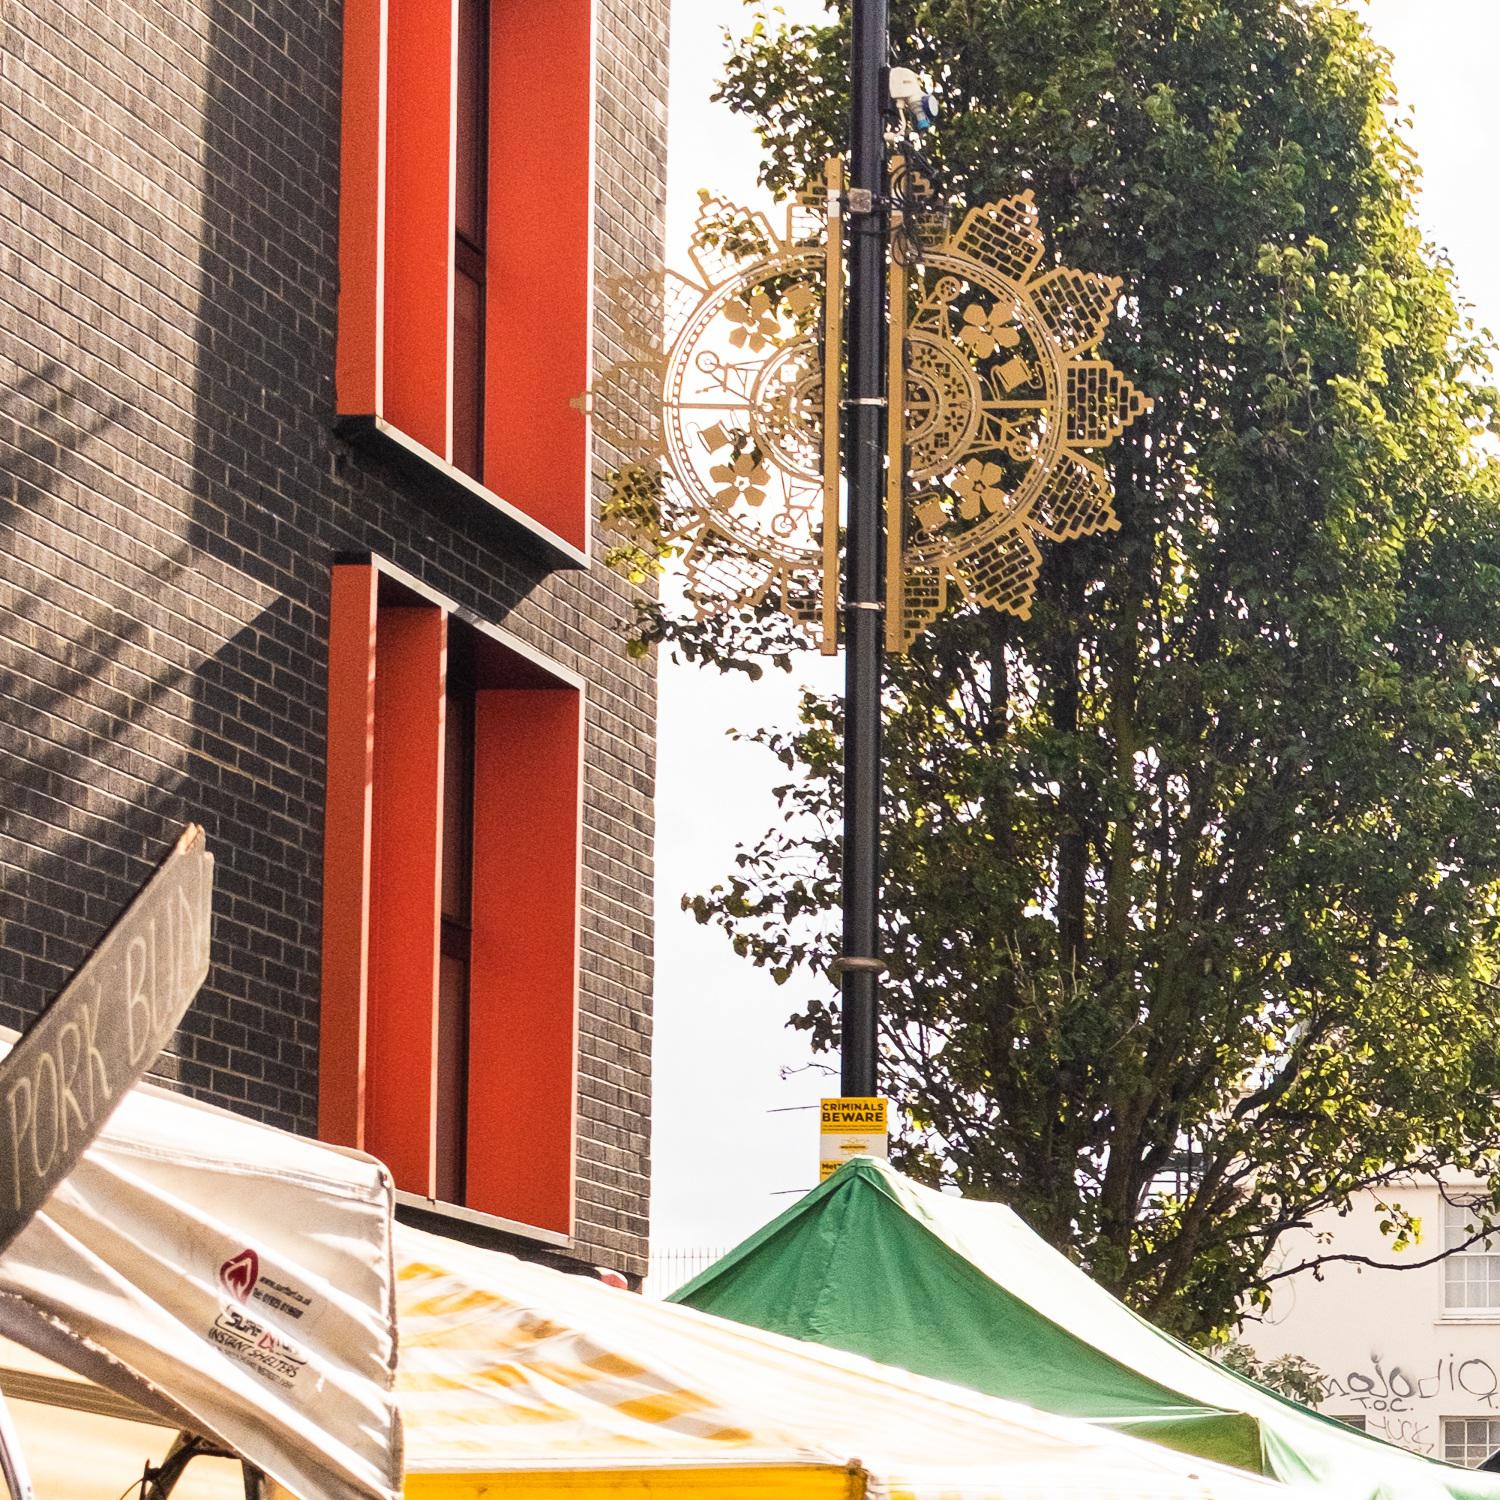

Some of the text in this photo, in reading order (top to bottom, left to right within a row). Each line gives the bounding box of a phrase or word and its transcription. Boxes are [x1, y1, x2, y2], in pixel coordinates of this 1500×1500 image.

[7, 885, 202, 1212] PORK BUN
[822, 1103, 884, 1111] CRIMINALS
[822, 1113, 883, 1122] BEWARE
[248, 1346, 299, 1379] SHELTERS
